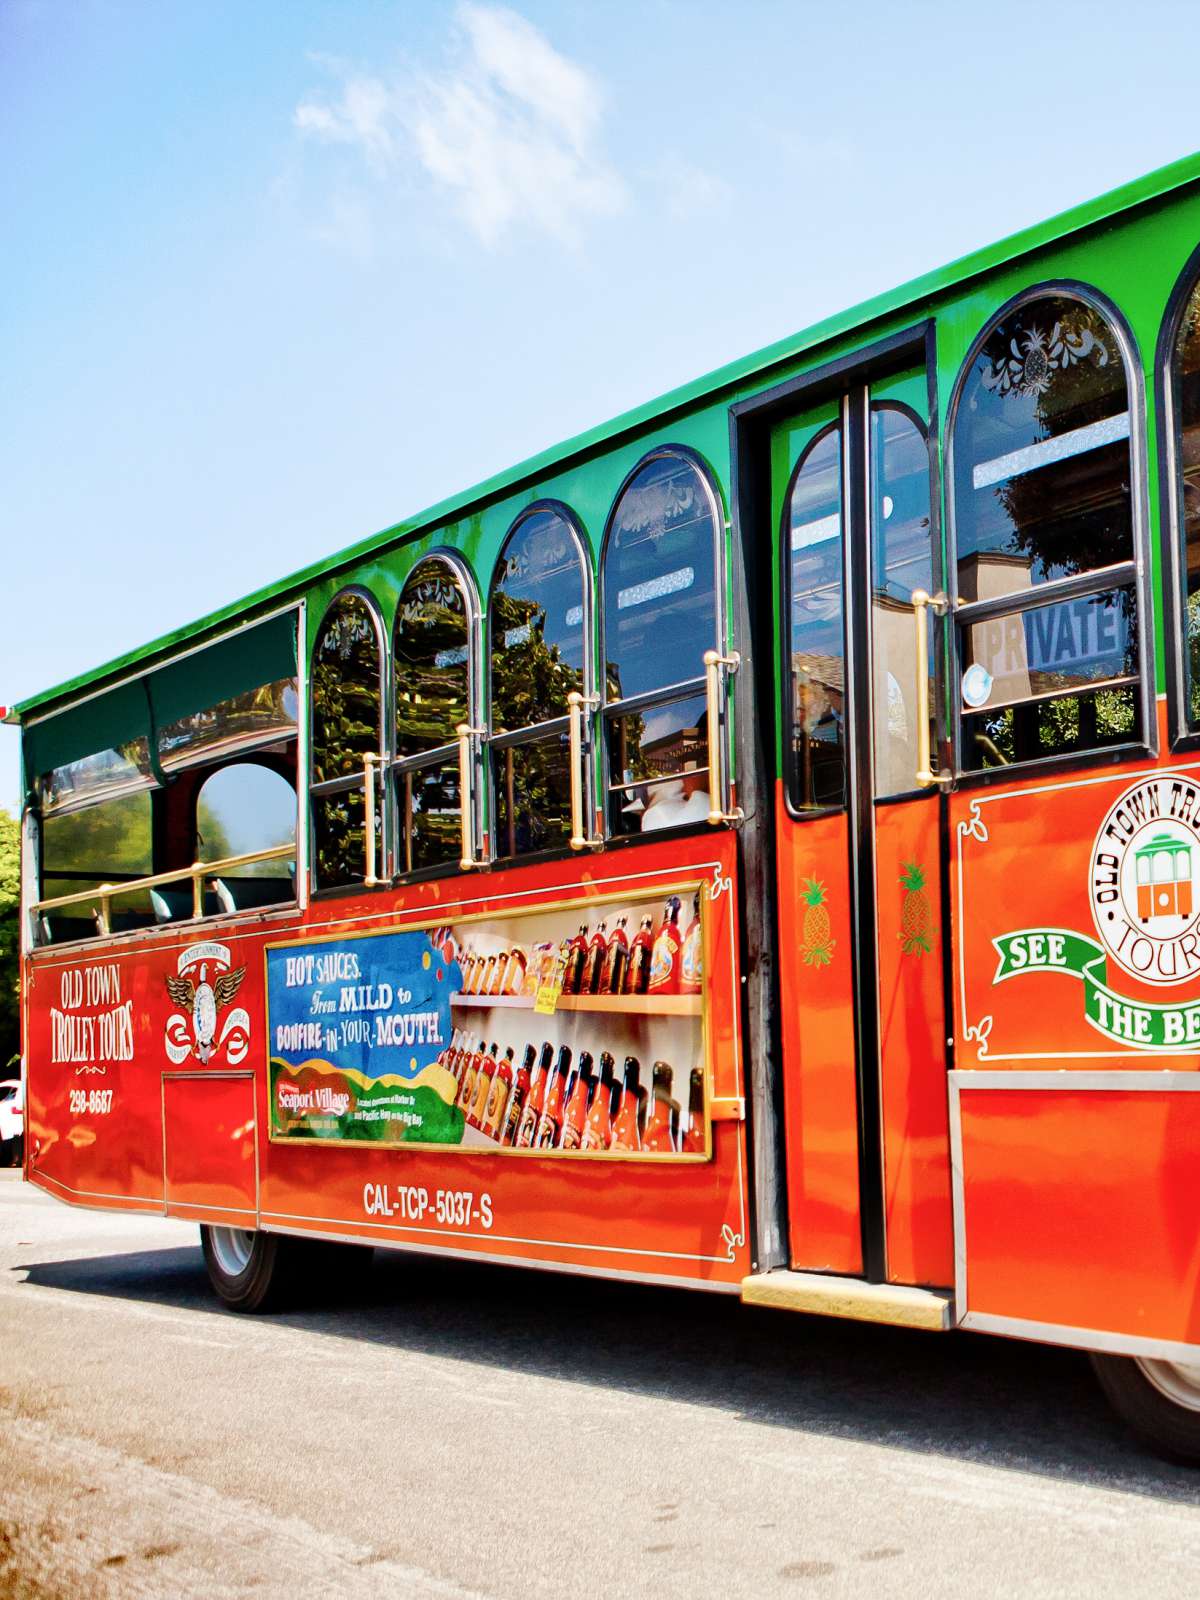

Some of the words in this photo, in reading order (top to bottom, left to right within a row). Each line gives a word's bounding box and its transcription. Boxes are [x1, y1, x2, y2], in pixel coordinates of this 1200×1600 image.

[983, 602, 1117, 673] PRIVATE
[1106, 784, 1160, 846] TOWN
[1094, 853, 1119, 904] OLD
[60, 969, 83, 1009] OLD
[85, 964, 121, 1007] TOWN
[286, 955, 314, 987] HOT
[316, 952, 362, 984] SAUCES.
[1009, 934, 1067, 968] SEE
[1093, 991, 1153, 1044] THE
[309, 990, 337, 1015] From
[338, 983, 394, 1013] MILD
[397, 987, 412, 1005] to
[50, 1007, 97, 1063] TROLLEY
[98, 1000, 135, 1062] TOURS
[69, 1089, 113, 1115] 298-8687
[279, 1088, 314, 1113] Seaport
[315, 1087, 349, 1116] Village
[363, 1182, 493, 1229] CAL-TCP-5037-S
